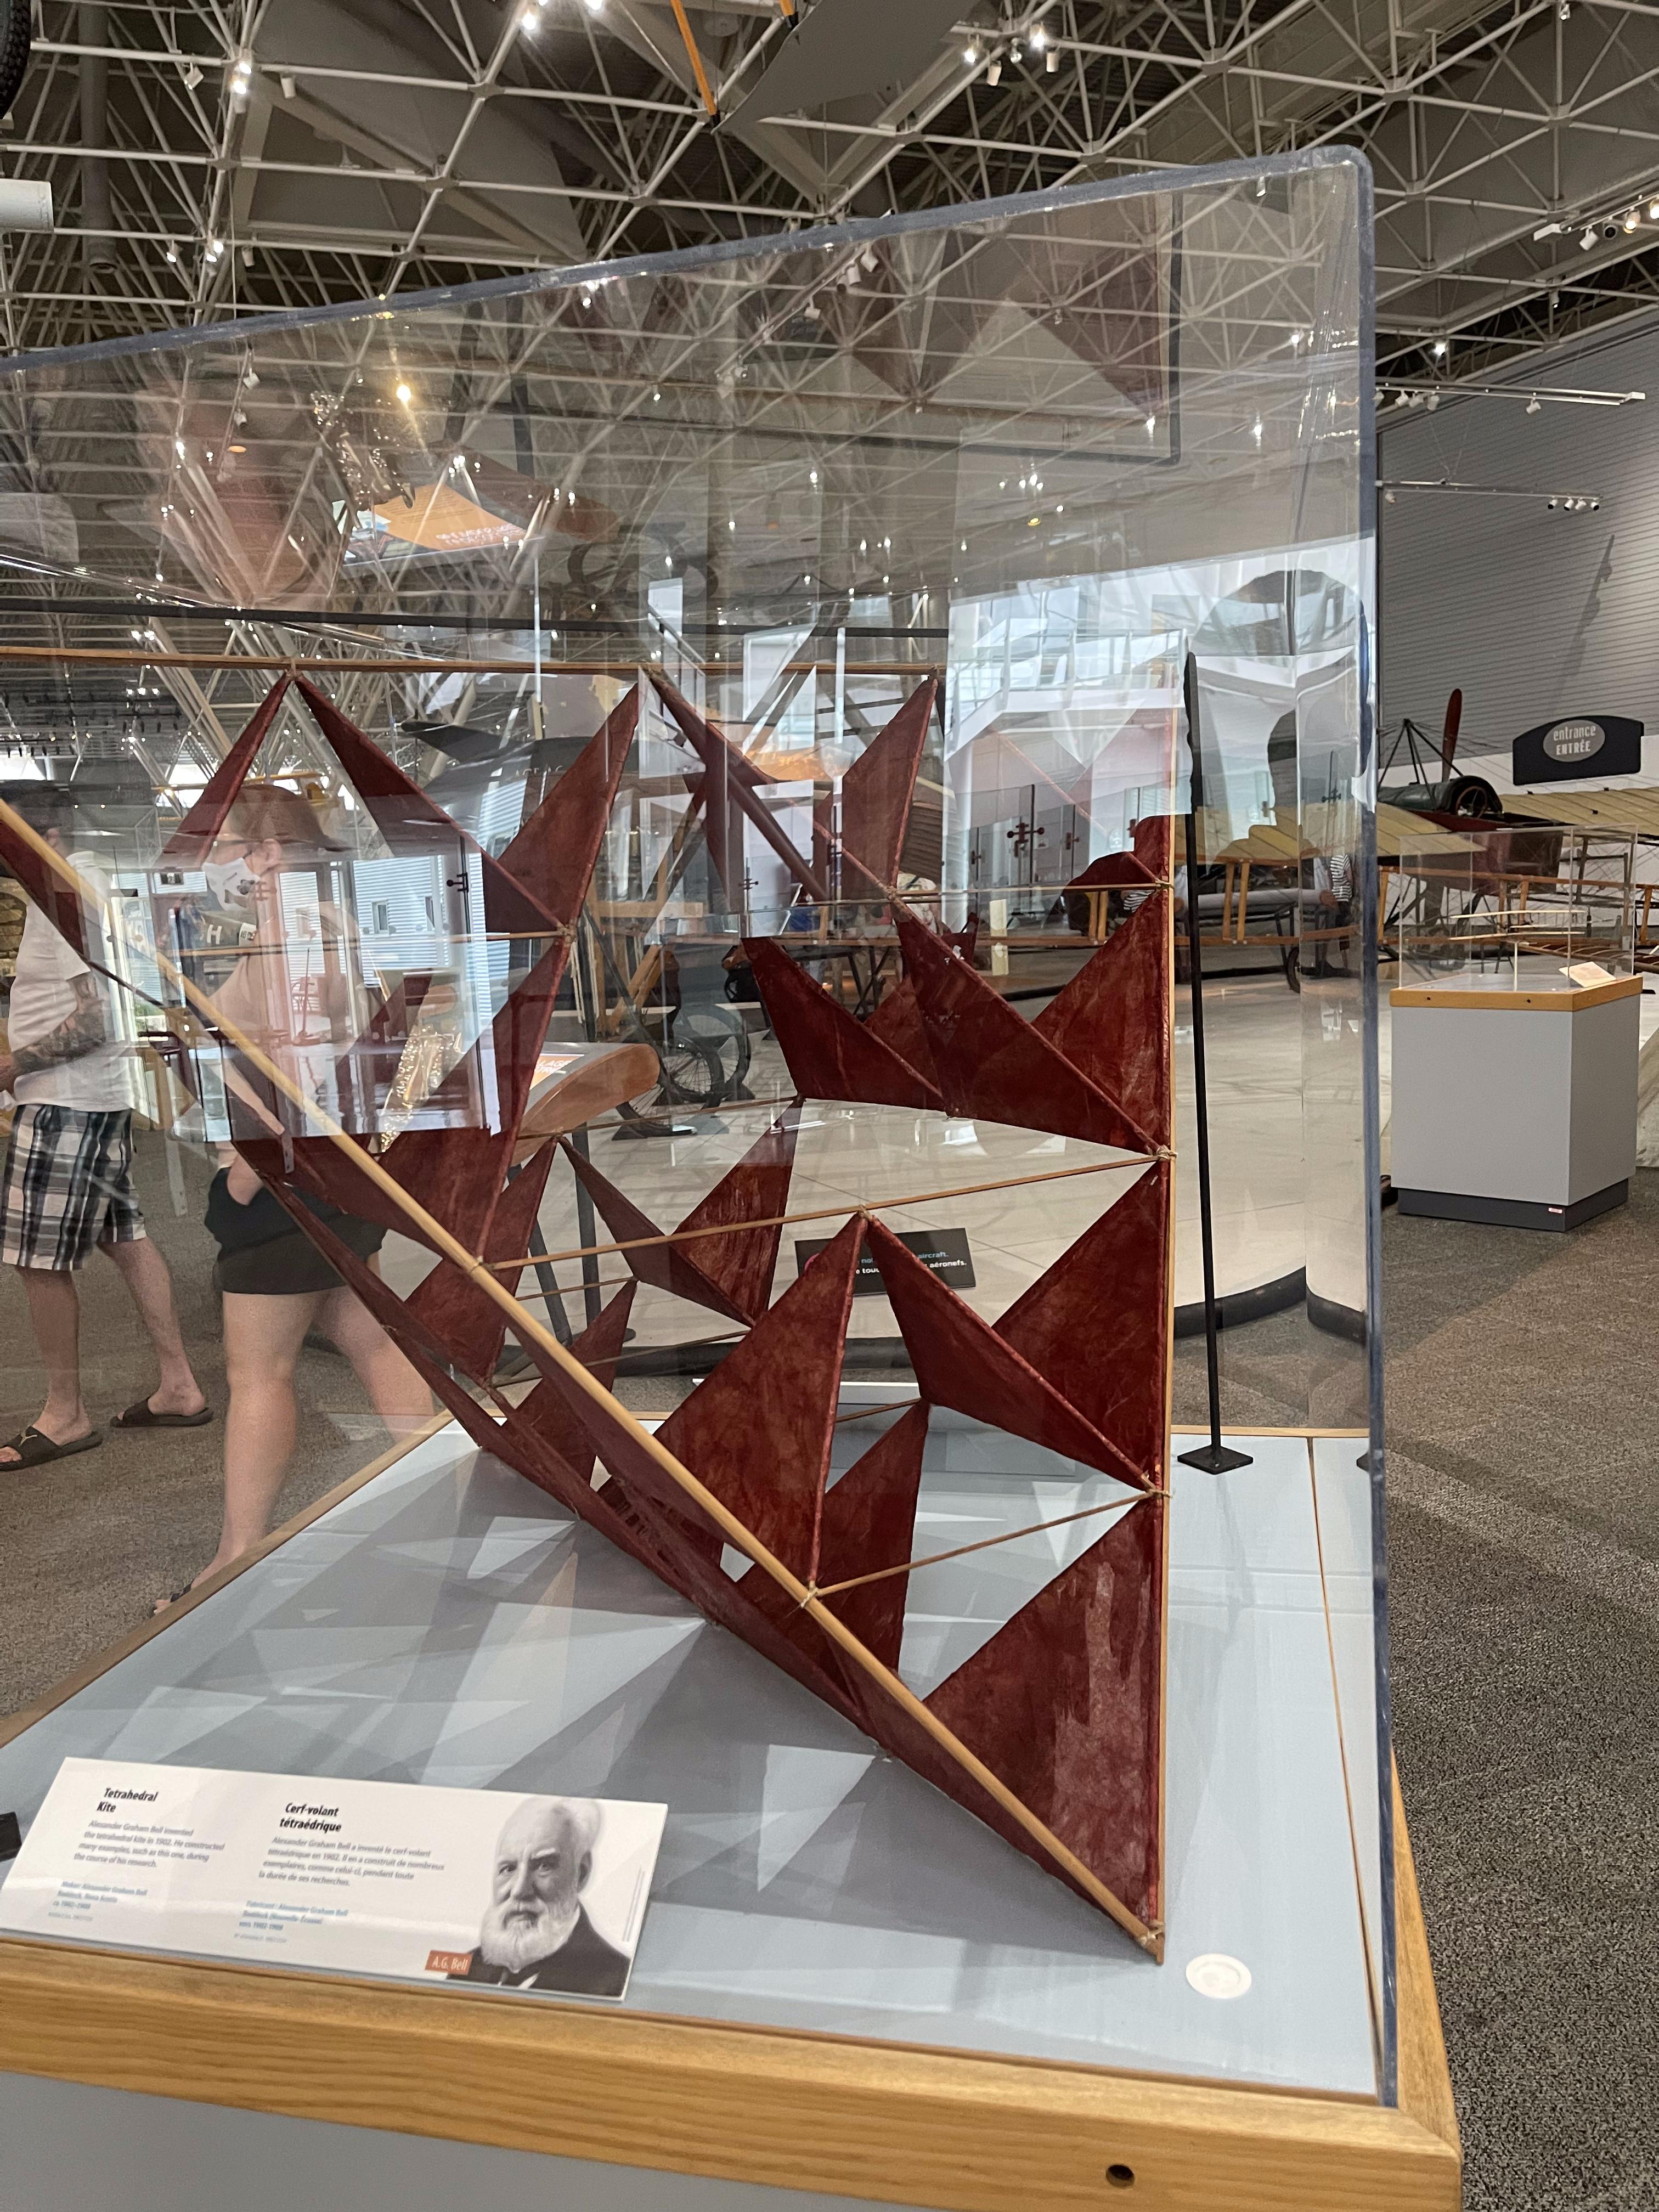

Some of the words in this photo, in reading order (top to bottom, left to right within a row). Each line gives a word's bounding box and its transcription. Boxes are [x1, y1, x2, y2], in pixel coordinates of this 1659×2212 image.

[1553, 725, 1596, 742] entrance
[1556, 739, 1590, 755] ENTRÉE
[929, 1259, 967, 1268] aéronefs.
[104, 1787, 159, 1802] Tetrahedral
[97, 1801, 116, 1813] Kite
[285, 1802, 340, 1817] Cerf-volant
[122, 1823, 150, 1832] Graham
[279, 1817, 342, 1834] tétraédrique
[156, 1837, 173, 1846] 1902.
[184, 1841, 225, 1851] constructed
[272, 1837, 308, 1847] Alexander
[308, 1839, 336, 1849] Graham
[336, 1842, 352, 1850] Bell
[357, 1843, 384, 1853] inventé
[186, 1852, 210, 1863] during
[267, 1848, 311, 1860] tétraédrique
[322, 1853, 341, 1862] 1902.
[341, 1854, 348, 1862] Il
[364, 1857, 396, 1866] construit
[407, 1861, 445, 1871] nombreux
[258, 1870, 266, 1878] la
[266, 1871, 287, 1881] durée
[287, 1873, 297, 1881] de
[310, 1876, 351, 1887] recherches.
[307, 1865, 335, 1873] comme
[362, 1867, 394, 1879] pendant
[394, 1871, 414, 1880] toute
[450, 1957, 469, 1972] Bell
